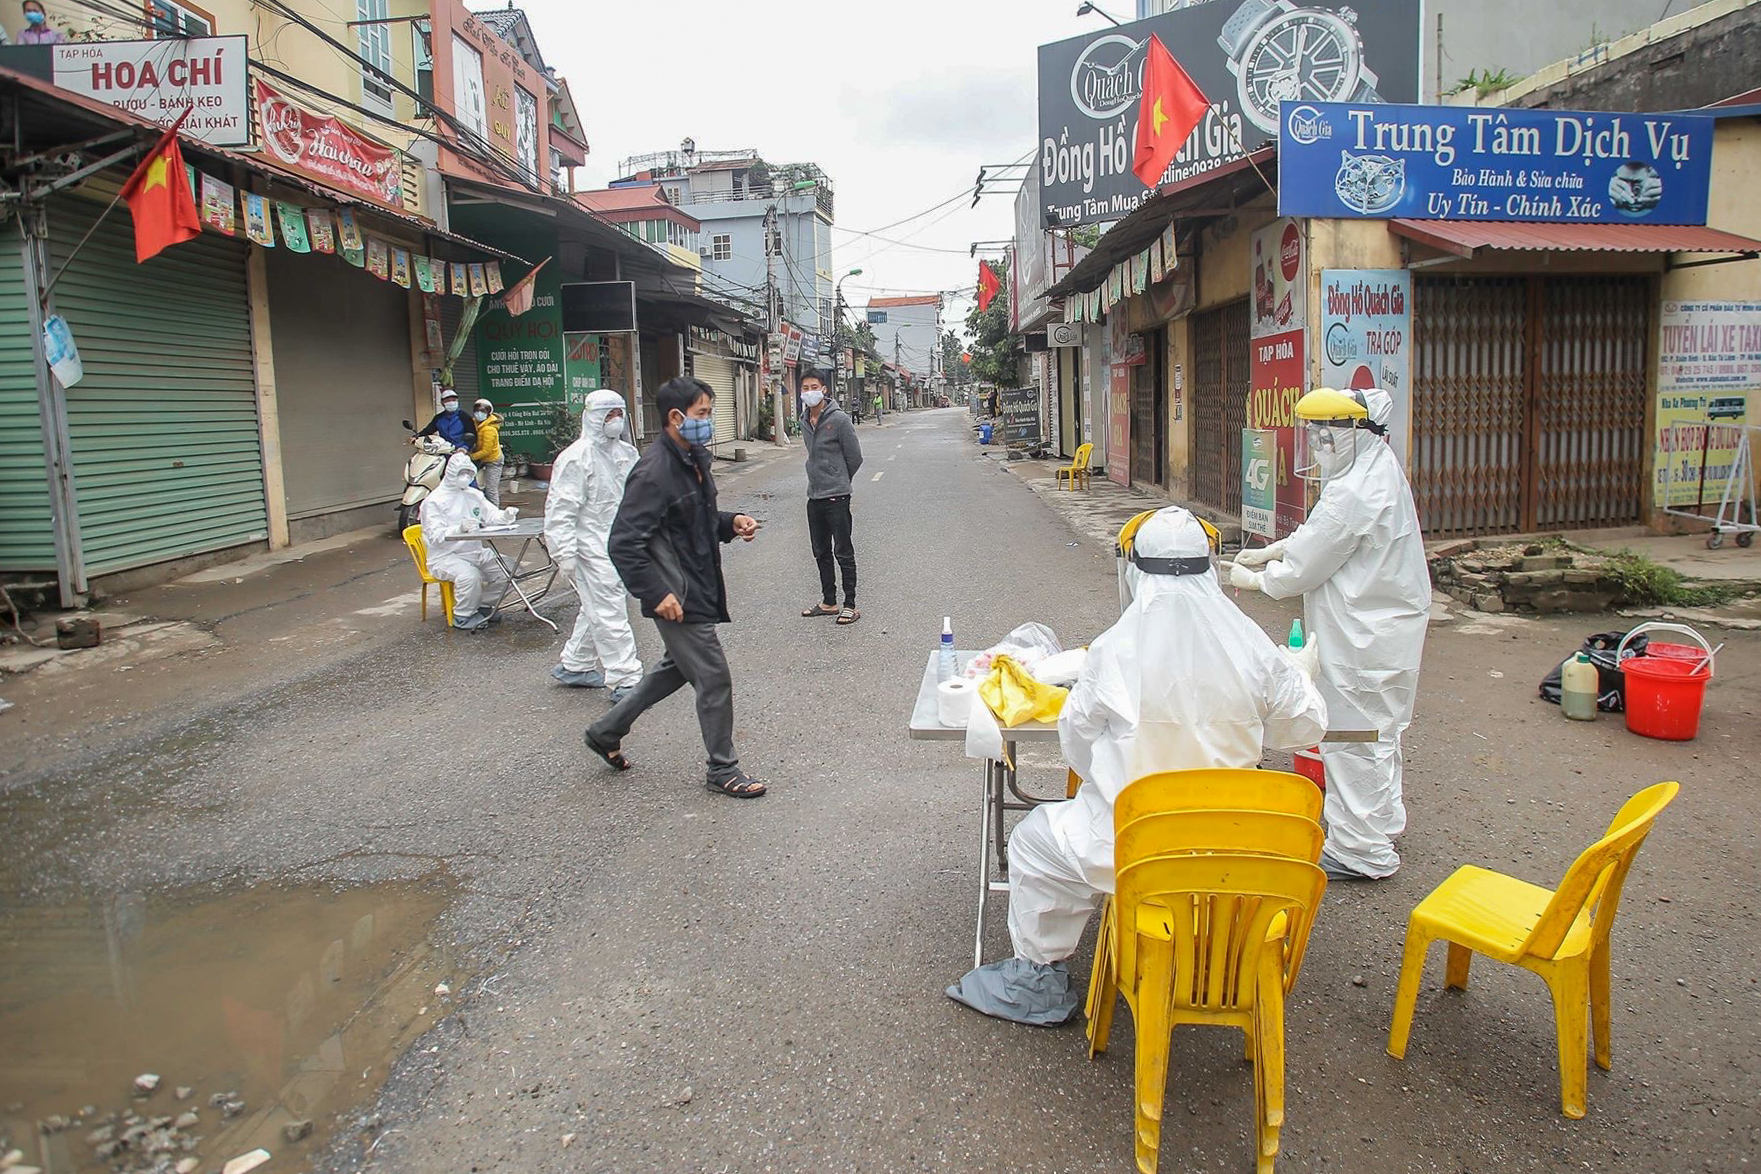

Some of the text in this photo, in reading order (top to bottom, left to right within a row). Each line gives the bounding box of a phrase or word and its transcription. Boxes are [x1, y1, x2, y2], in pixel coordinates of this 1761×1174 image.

[60, 47, 104, 61] TẠP HÓA
[92, 48, 225, 91] HOA CHÍ
[159, 95, 193, 110] BÁNH
[198, 95, 223, 110] KẸO
[205, 113, 239, 129] KHÁT
[1042, 126, 1094, 195] Đồng
[1099, 113, 1128, 177] Hồ
[1205, 100, 1243, 160] Gia
[1348, 109, 1690, 170] Trung Tâm Dịch Vụ
[1452, 168, 1583, 190] Bảo Hành & Sửa chữa
[1083, 197, 1109, 216] Tâm
[1111, 194, 1139, 213] Mua
[1427, 195, 1453, 219] Uy
[1457, 193, 1488, 217] Tín
[1506, 192, 1563, 218] Chính
[1566, 194, 1601, 219] Xác
[1328, 279, 1350, 324] Đồng
[1352, 279, 1363, 315] Hồ
[1364, 283, 1390, 319] Quách
[1391, 283, 1404, 315] Gia
[1366, 323, 1402, 355] TRẢ GÓP
[1662, 313, 1698, 354] TUYỂN
[1701, 318, 1718, 353] LÁI
[1721, 324, 1736, 353] XE
[1258, 340, 1294, 366] TẠP HÓA
[1254, 377, 1300, 429] QUÁCH
[1245, 458, 1269, 491] 4G
